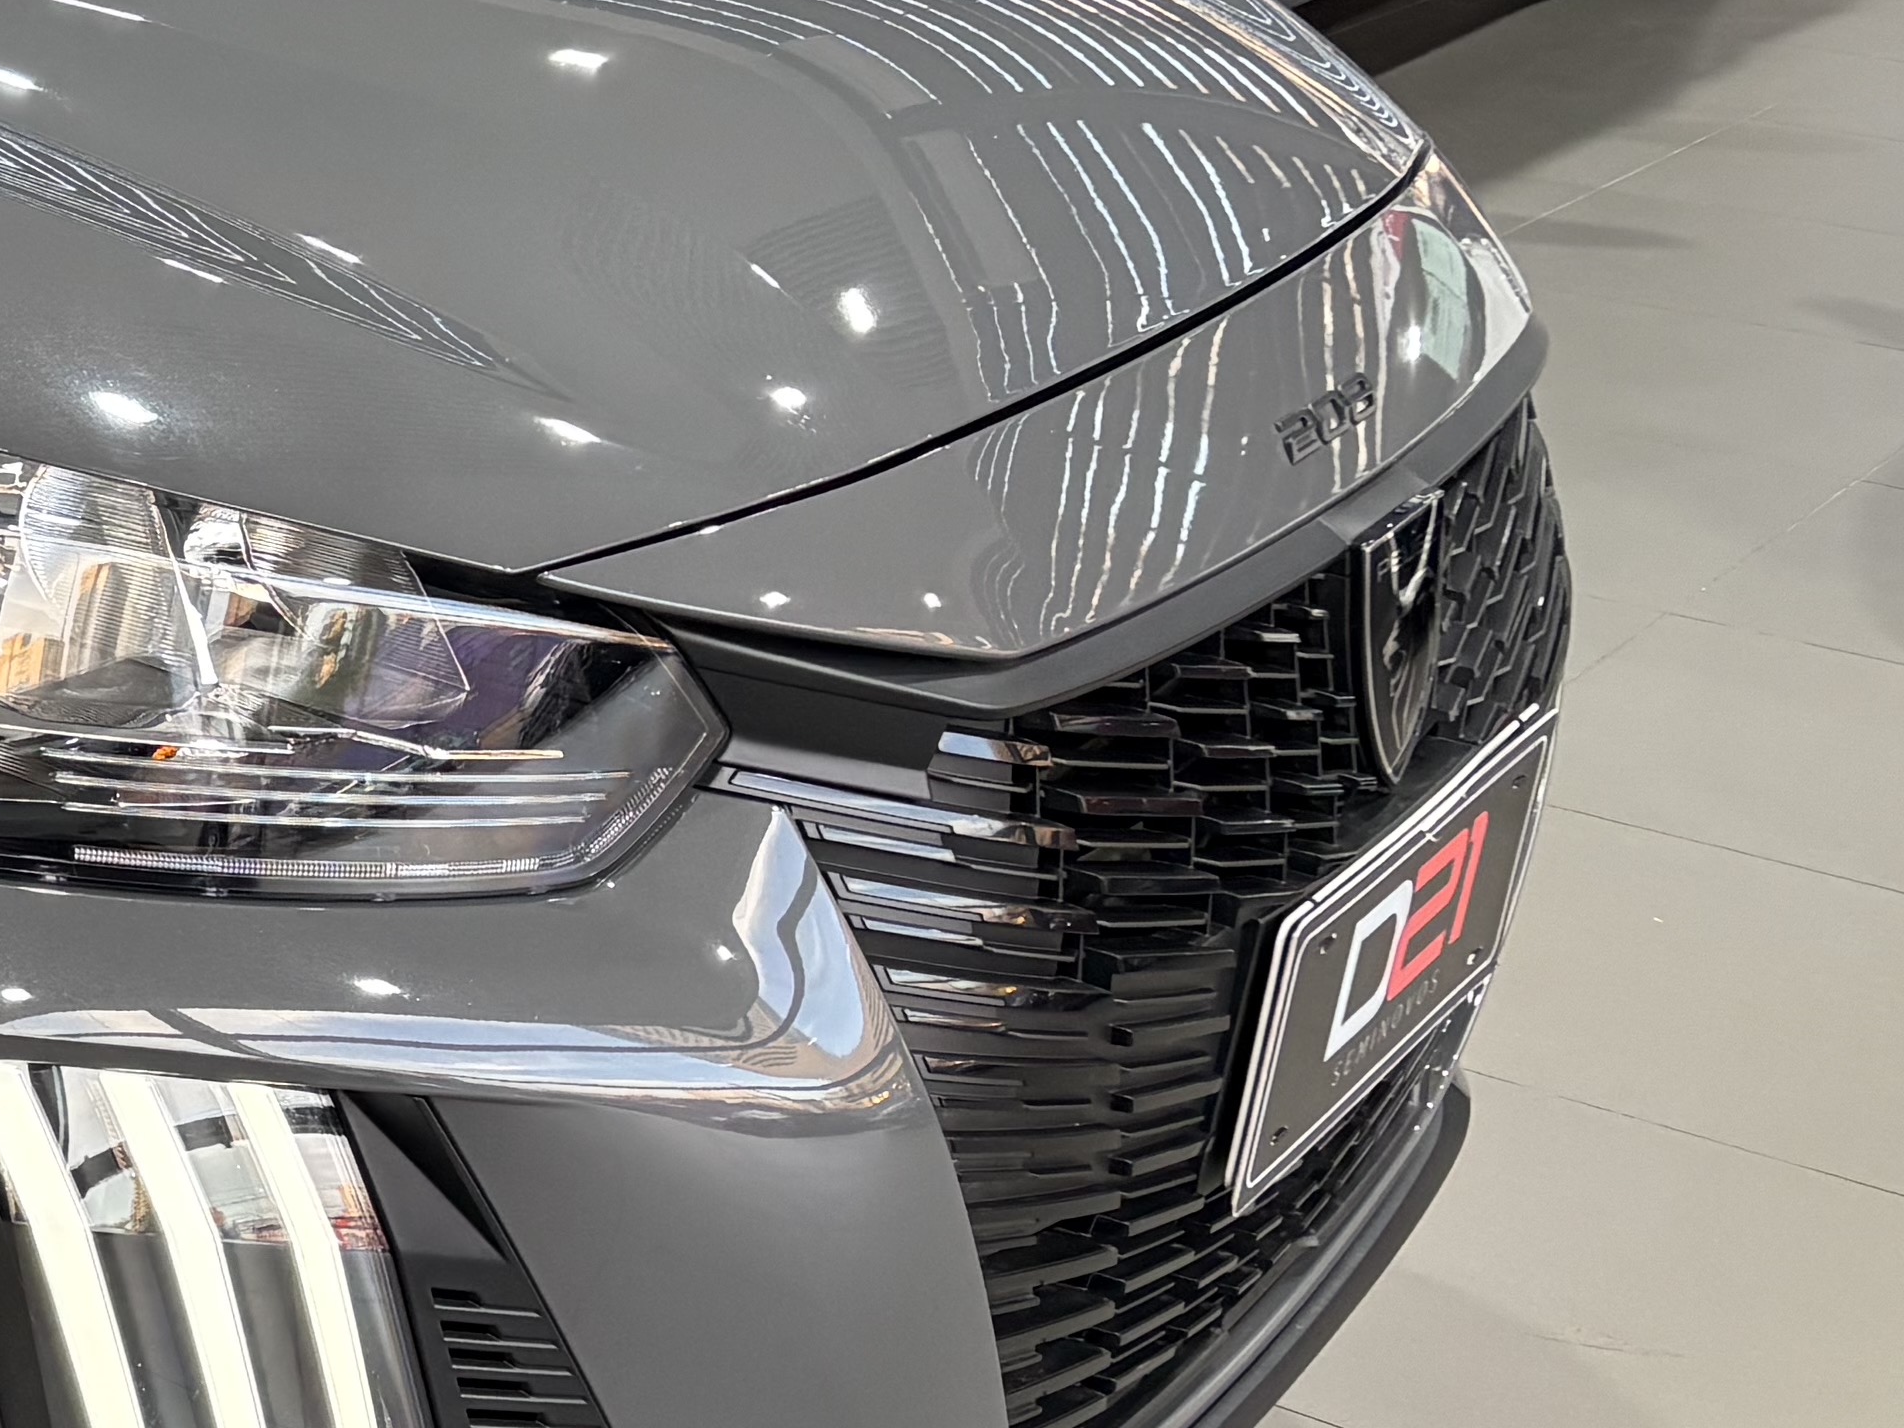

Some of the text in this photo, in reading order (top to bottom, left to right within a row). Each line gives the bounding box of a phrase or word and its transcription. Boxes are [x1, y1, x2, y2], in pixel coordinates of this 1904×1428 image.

[1274, 372, 1377, 466] 208
[1323, 811, 1489, 1063] D21
[1330, 969, 1441, 1087] SEMINOVOS
